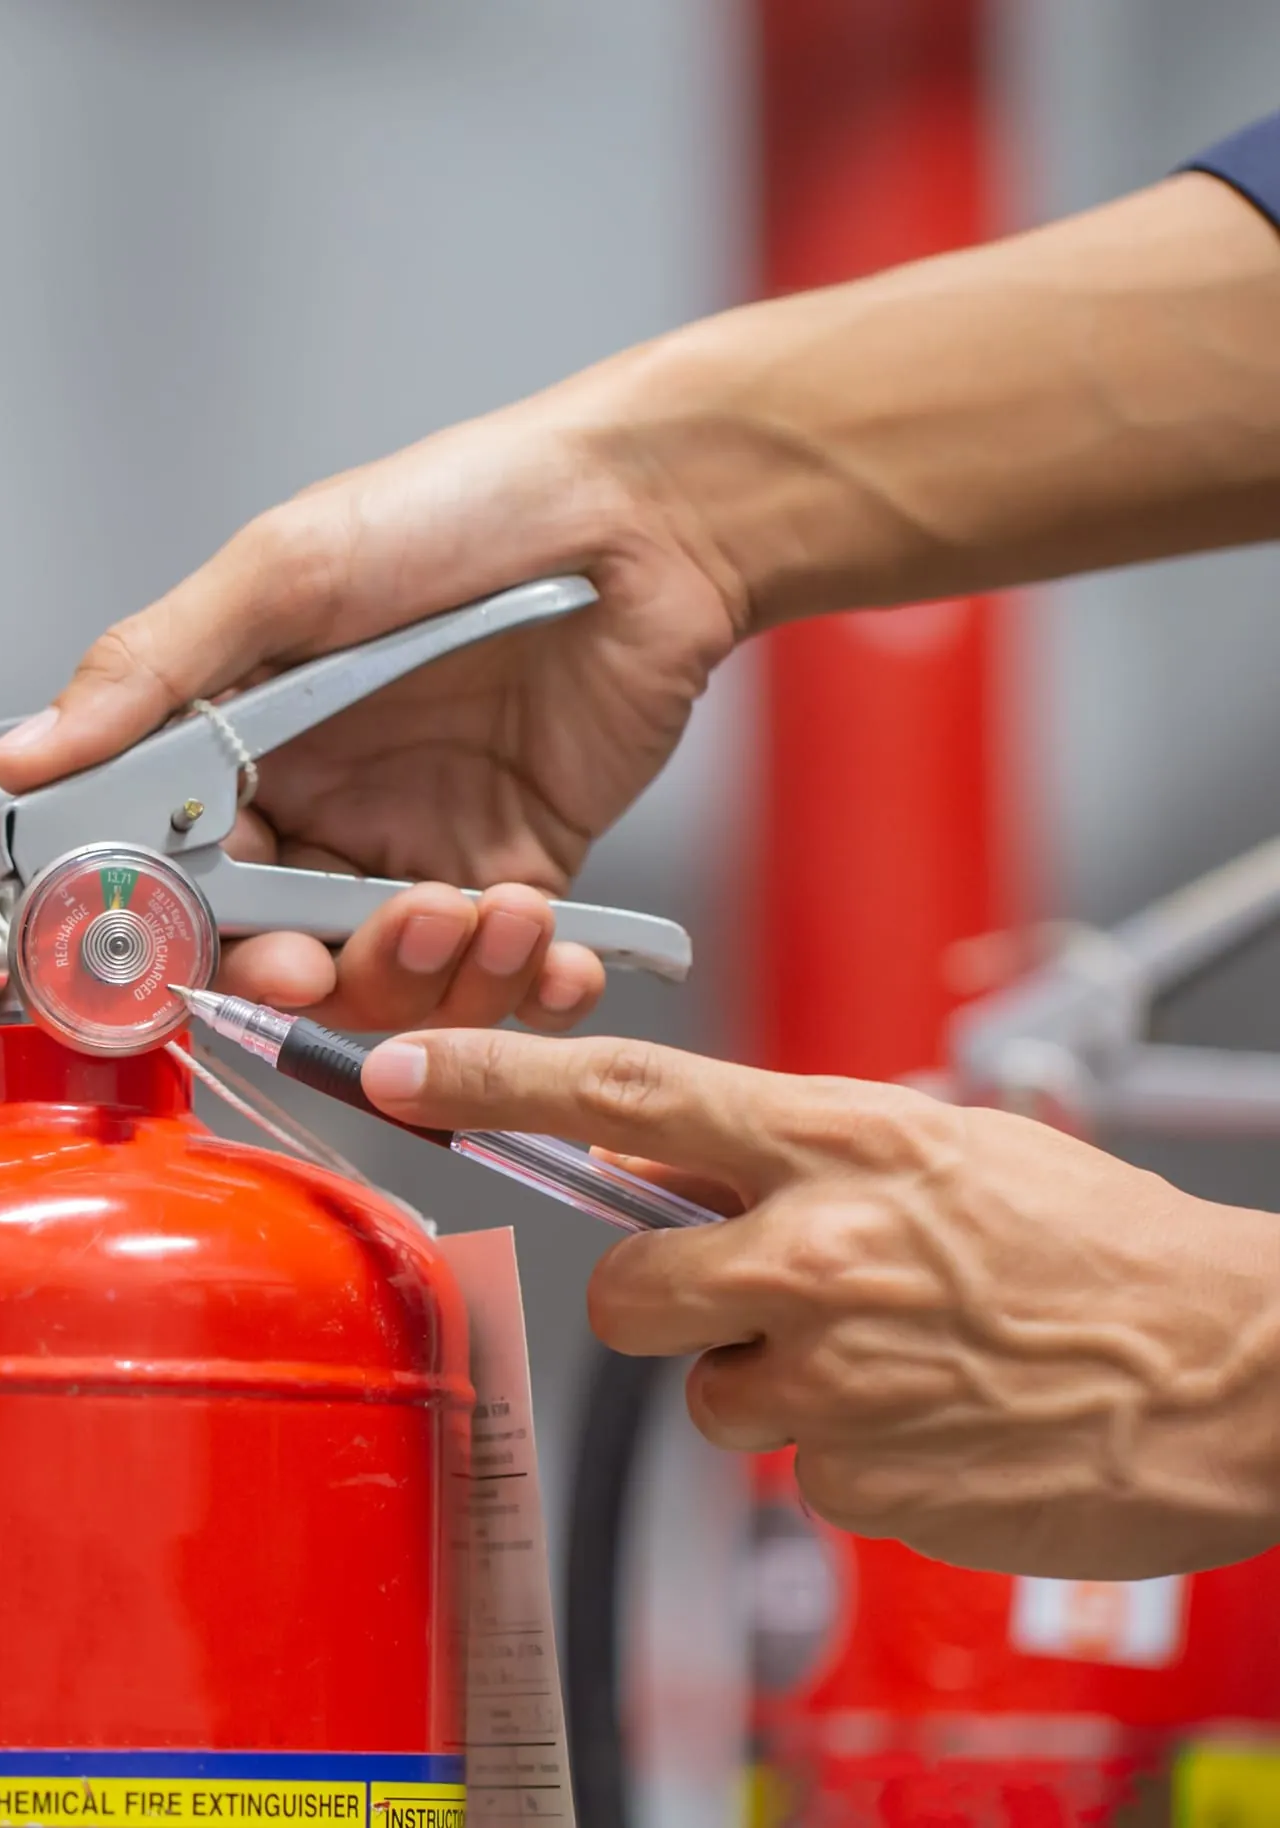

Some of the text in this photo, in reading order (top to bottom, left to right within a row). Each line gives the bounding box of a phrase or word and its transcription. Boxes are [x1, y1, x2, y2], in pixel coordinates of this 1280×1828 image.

[55, 903, 90, 968] RECHARGE
[134, 912, 168, 1001] OVERCHARGED
[125, 1792, 183, 1817] FIRE
[193, 1793, 359, 1819] EXTINGUISHER
